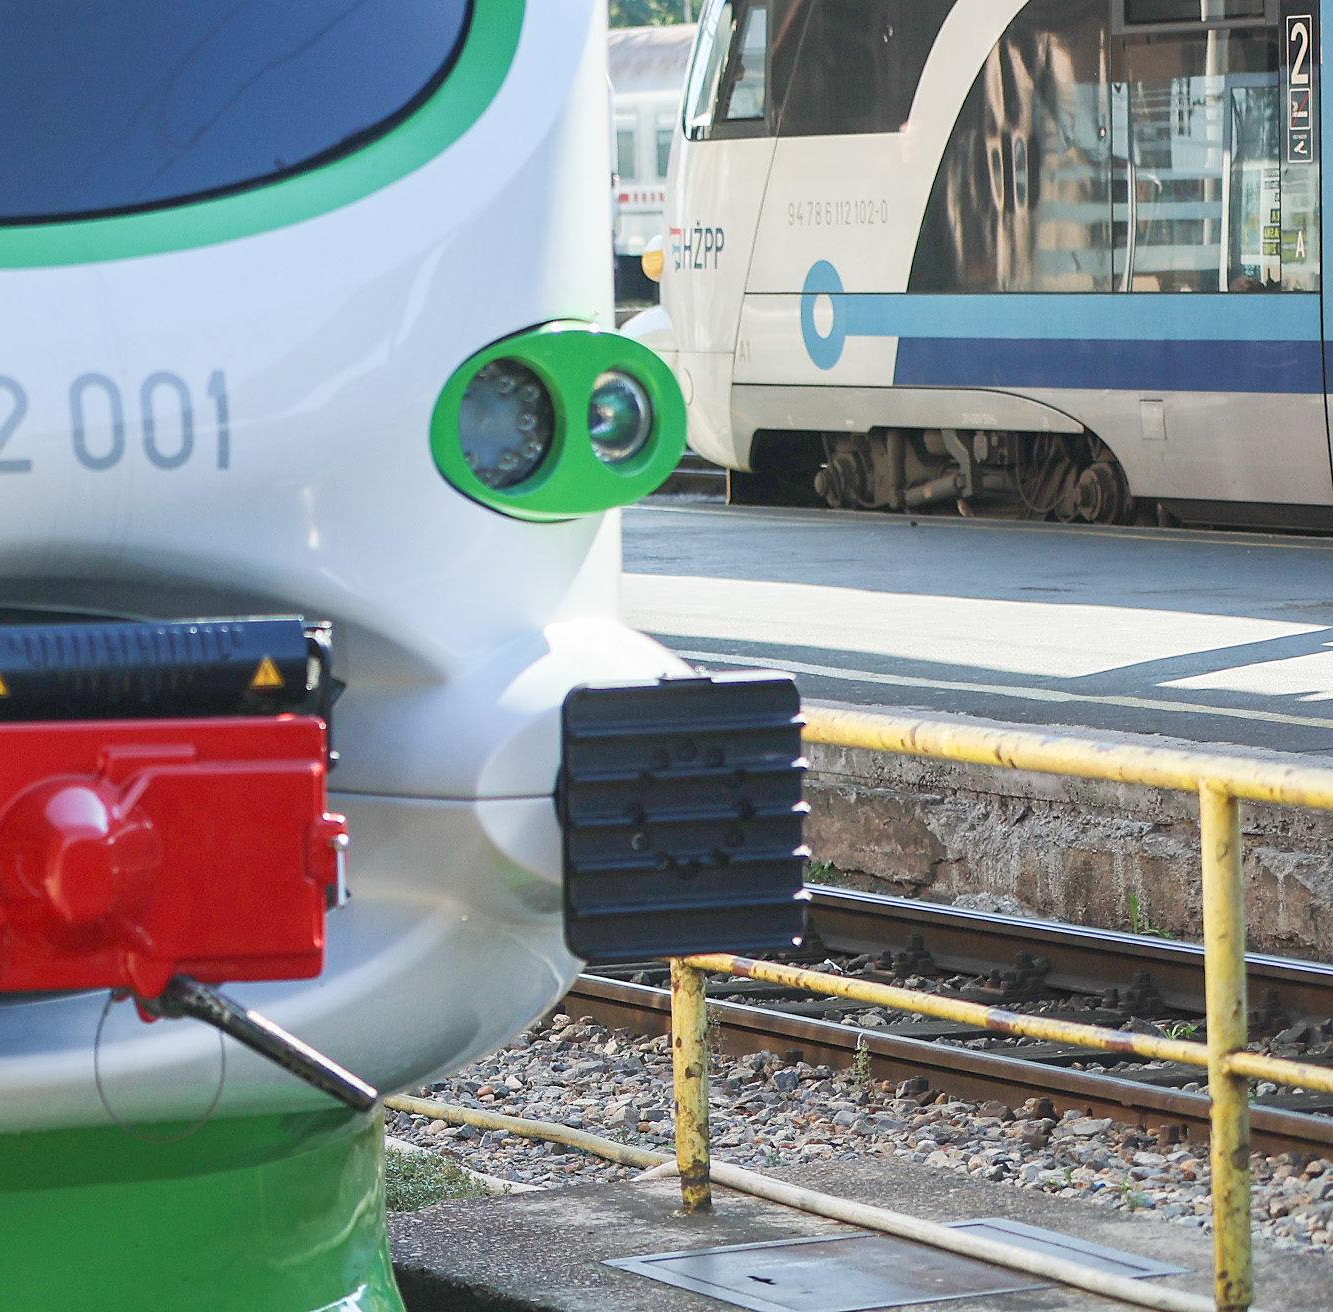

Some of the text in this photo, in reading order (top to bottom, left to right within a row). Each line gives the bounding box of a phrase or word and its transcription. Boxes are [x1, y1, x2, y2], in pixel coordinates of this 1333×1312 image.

[1289, 21, 1309, 85] 2
[788, 202, 803, 226] 94
[807, 201, 822, 226] 78
[683, 220, 725, 270] HŽPP
[67, 369, 231, 472] 001
